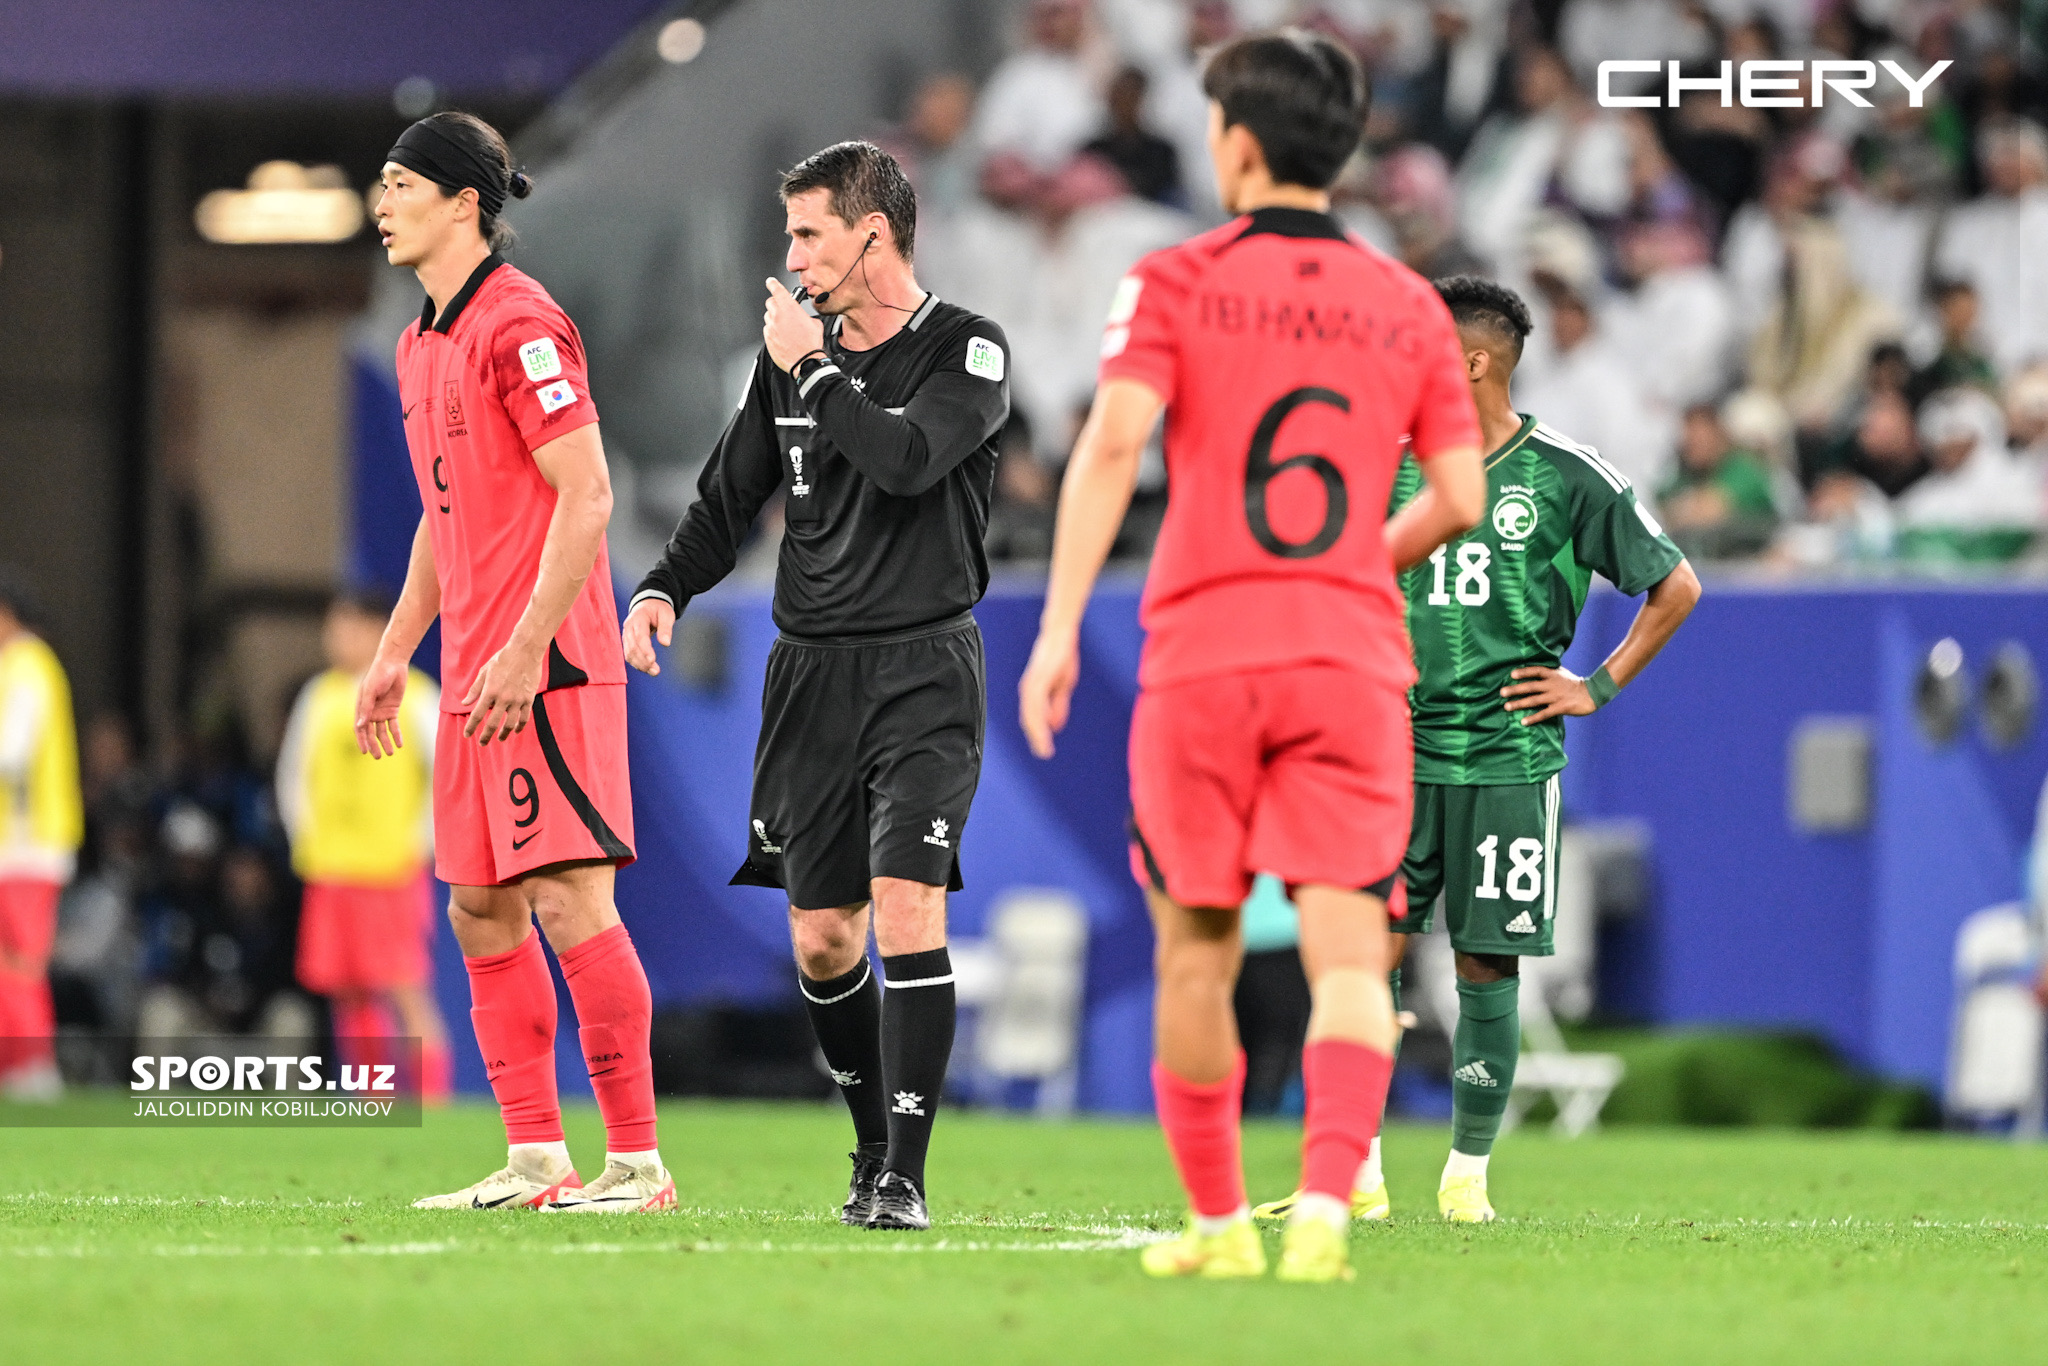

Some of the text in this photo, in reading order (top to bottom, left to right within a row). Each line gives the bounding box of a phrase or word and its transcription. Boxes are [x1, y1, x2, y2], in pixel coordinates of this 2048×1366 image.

[527, 346, 541, 355] AFC
[528, 351, 552, 365] LIVE
[448, 429, 468, 437] KOREA
[1244, 385, 1351, 560] 6
[433, 455, 449, 514] 9
[1501, 542, 1525, 551] SAUDI
[1428, 542, 1491, 606] 18
[509, 768, 539, 828] 9
[1475, 834, 1544, 902] 18
[1505, 923, 1537, 934] adidas
[1455, 1069, 1498, 1087] adidas
[892, 1105, 925, 1116] KELME
